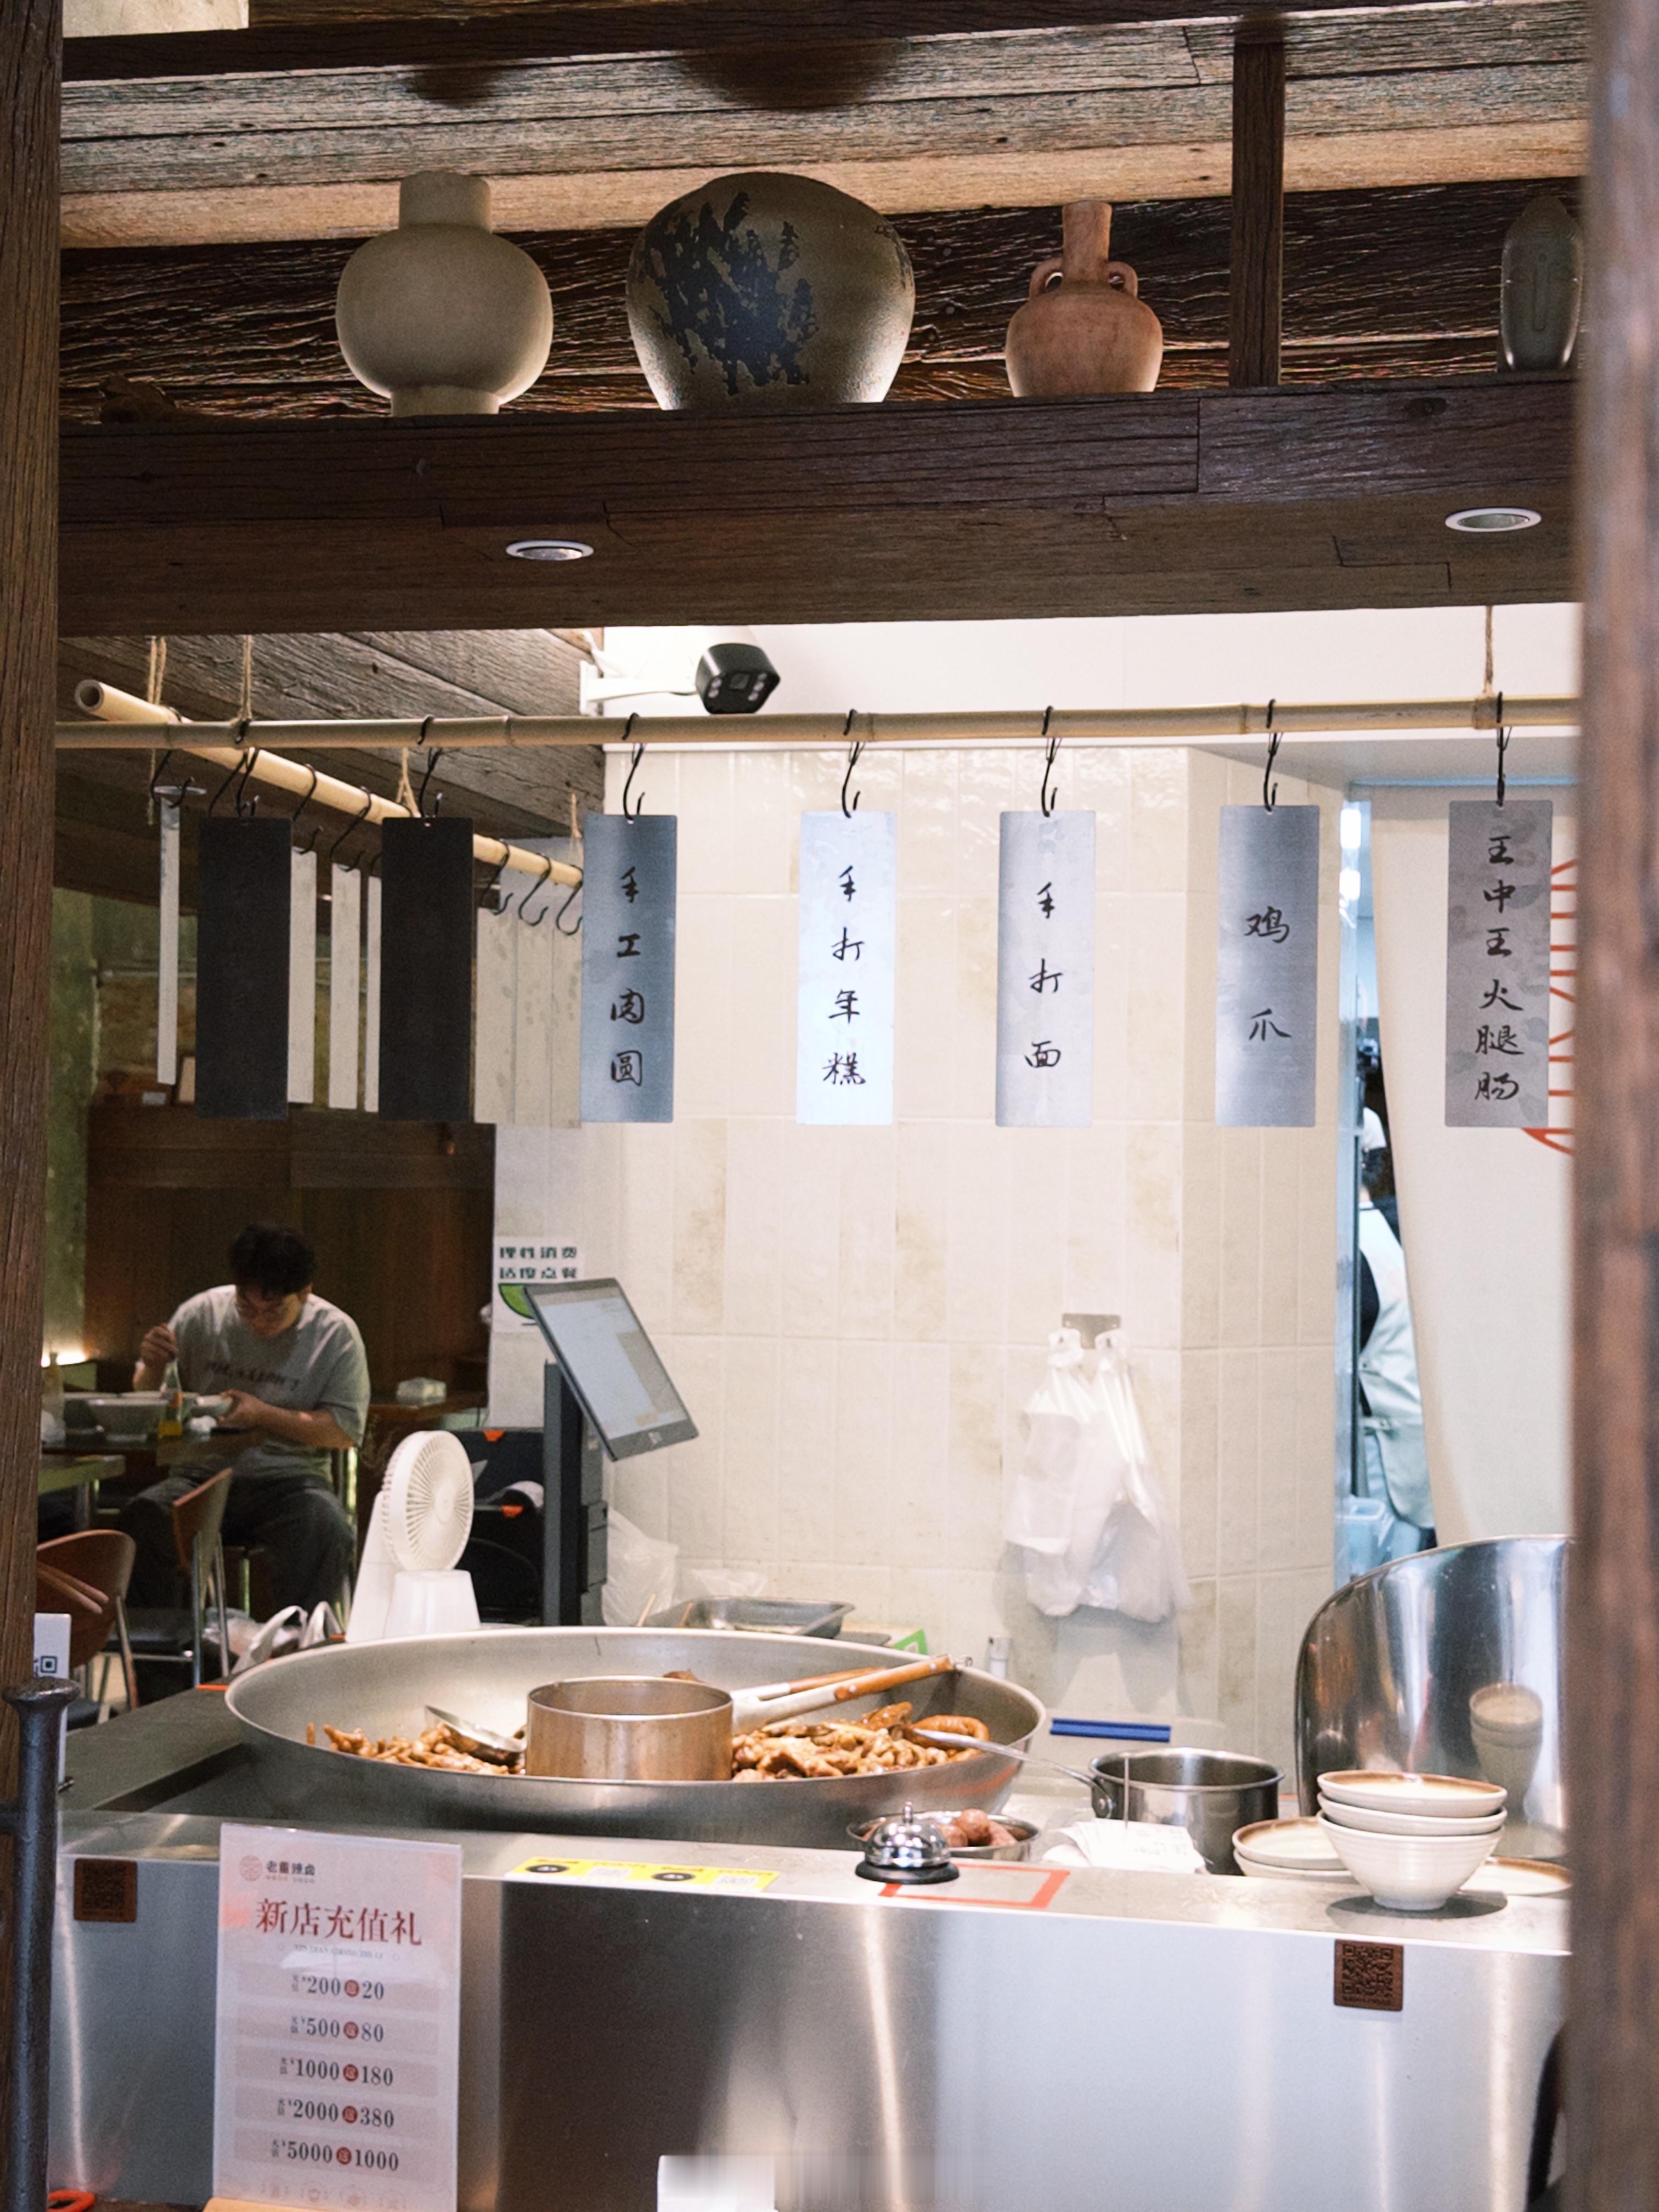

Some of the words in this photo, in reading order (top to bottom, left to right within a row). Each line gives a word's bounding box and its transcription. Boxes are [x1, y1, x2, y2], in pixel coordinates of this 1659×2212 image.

[823, 865, 866, 1085] 手打年糕
[1024, 882, 1063, 1068] 手打面
[1243, 905, 1291, 1041] 鸡爪
[1474, 836, 1525, 1101] 王中王火腿肠
[256, 1898, 422, 1945] 新店充值礼
[362, 1980, 384, 2000] 20
[362, 2022, 384, 2042] 80
[362, 2066, 393, 2086] 180
[360, 2107, 394, 2128] 380
[356, 2149, 399, 2171] 1000
